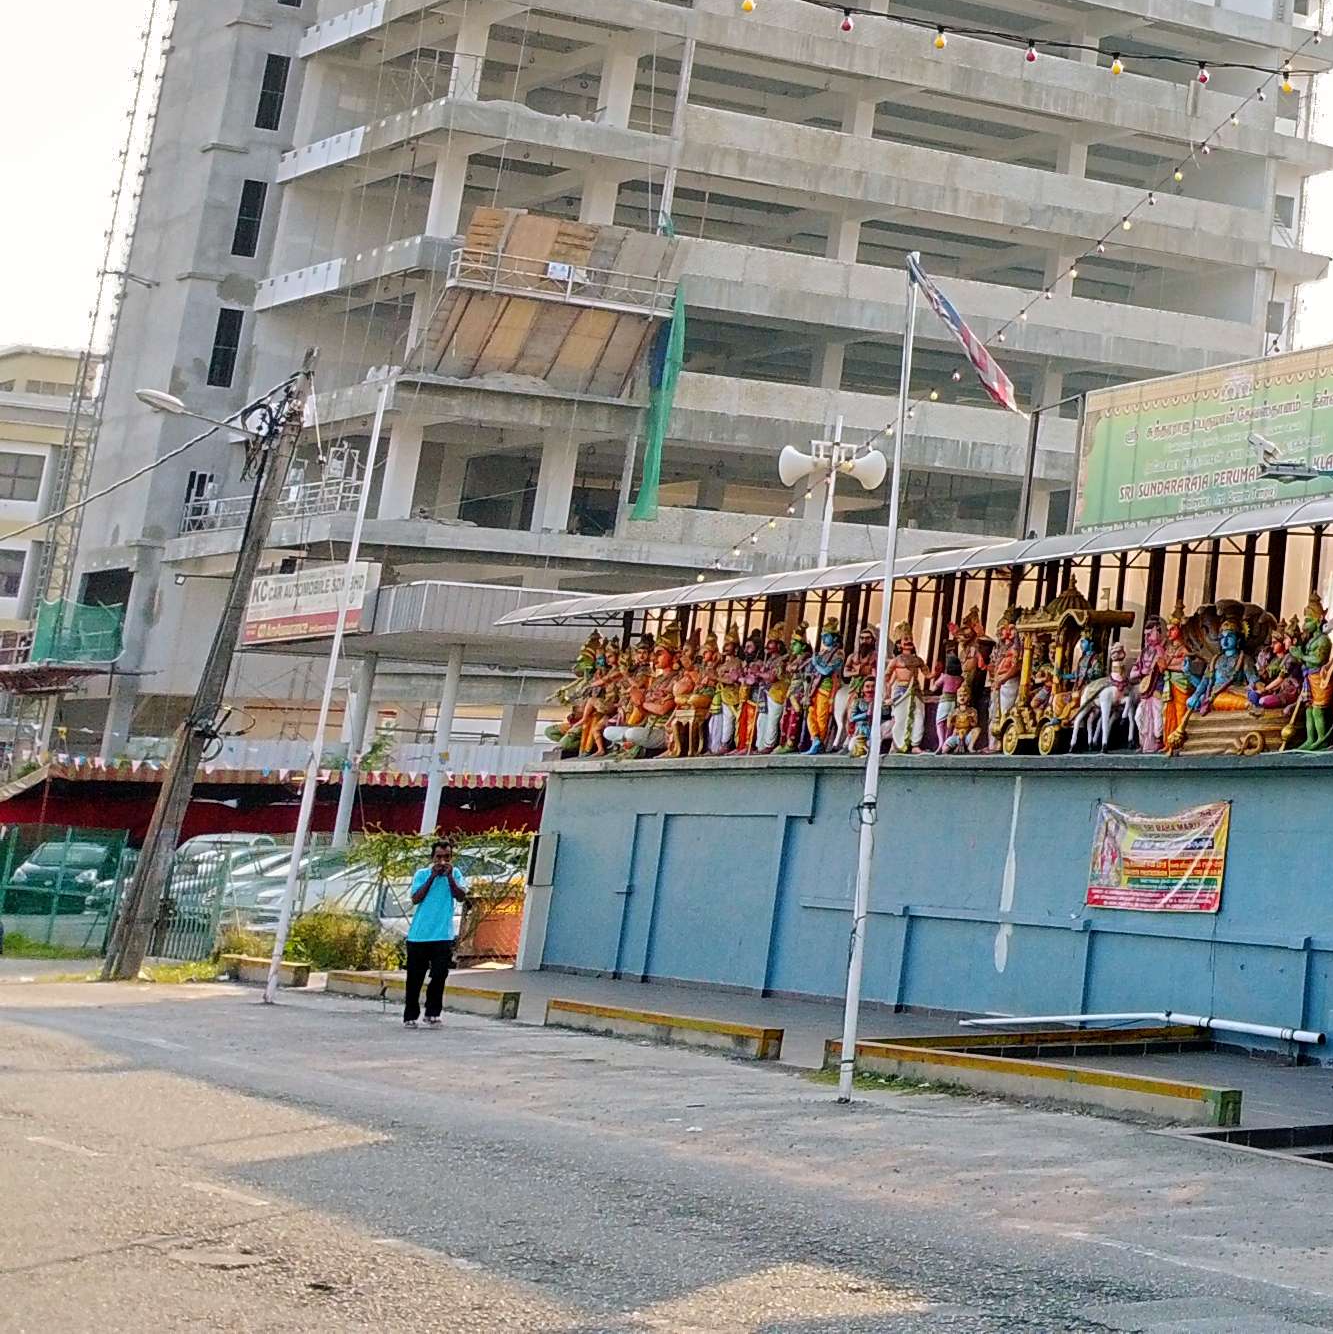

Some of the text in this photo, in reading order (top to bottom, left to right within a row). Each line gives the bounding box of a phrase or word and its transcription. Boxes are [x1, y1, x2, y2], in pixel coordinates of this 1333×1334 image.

[1120, 485, 1134, 501] SRI
[1138, 474, 1209, 498] SUNDARARAJA
[251, 580, 268, 603] KC
[268, 585, 283, 602] CAR
